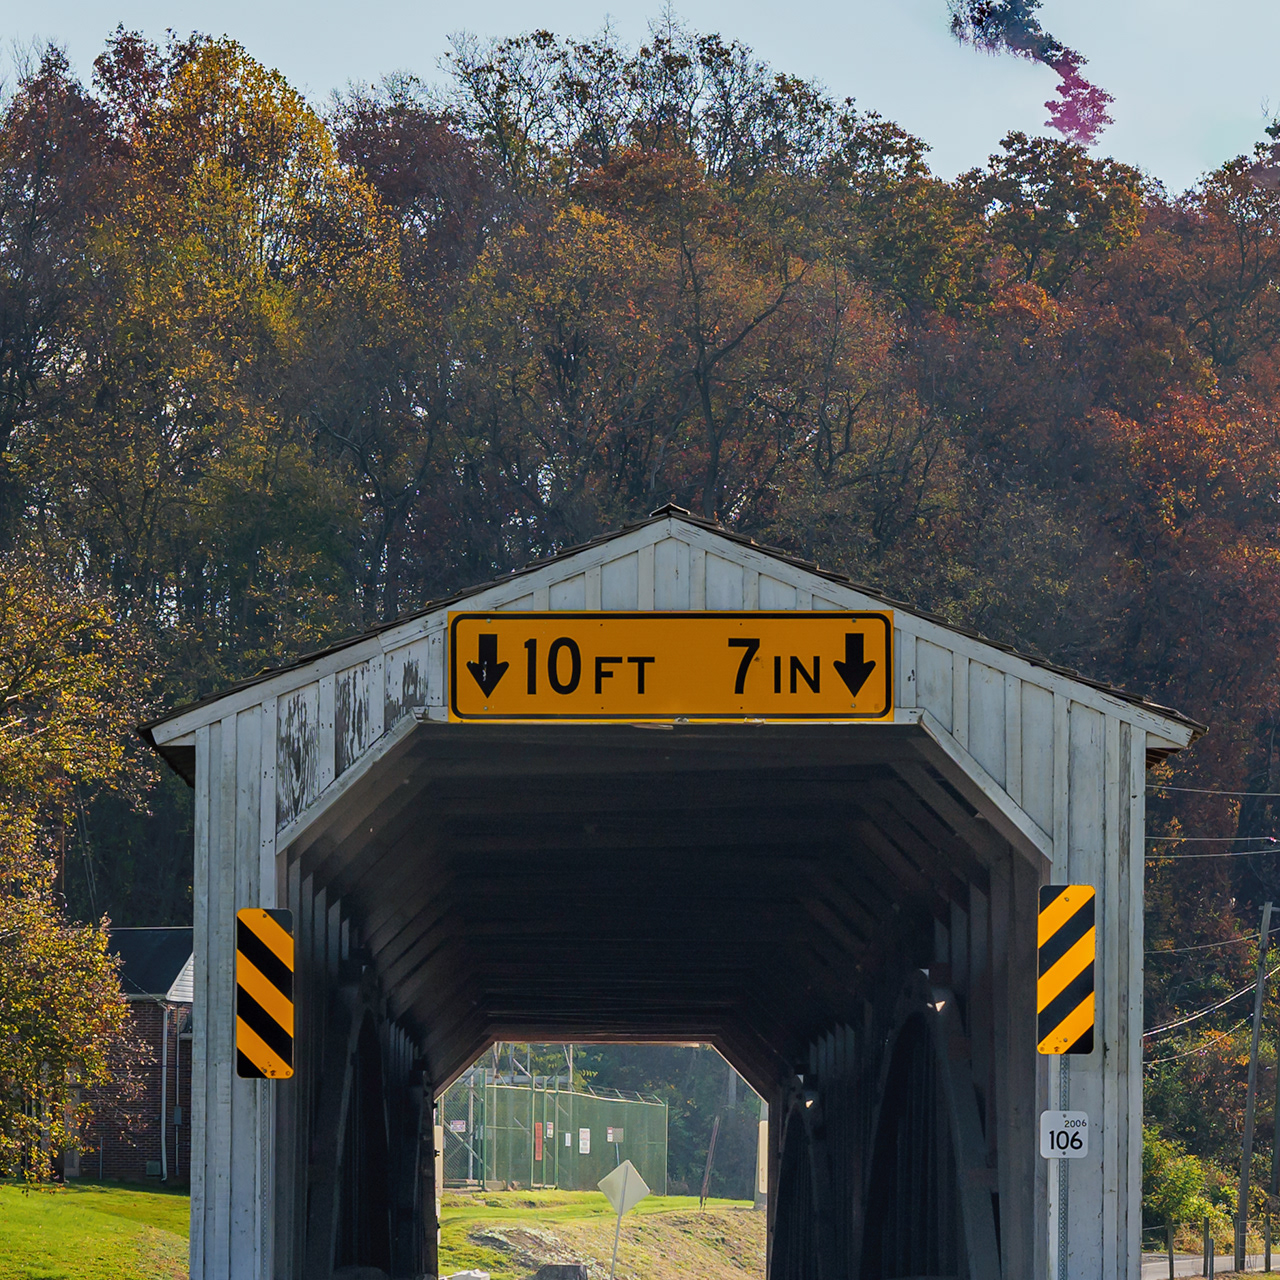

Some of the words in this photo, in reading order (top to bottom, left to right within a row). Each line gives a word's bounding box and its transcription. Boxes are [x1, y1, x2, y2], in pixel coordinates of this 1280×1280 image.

[524, 636, 582, 695] 10
[594, 656, 656, 695] FT
[727, 638, 761, 695] 7
[773, 655, 821, 694] IN
[1064, 1119, 1087, 1128] 2006
[1049, 1130, 1083, 1150] 106
